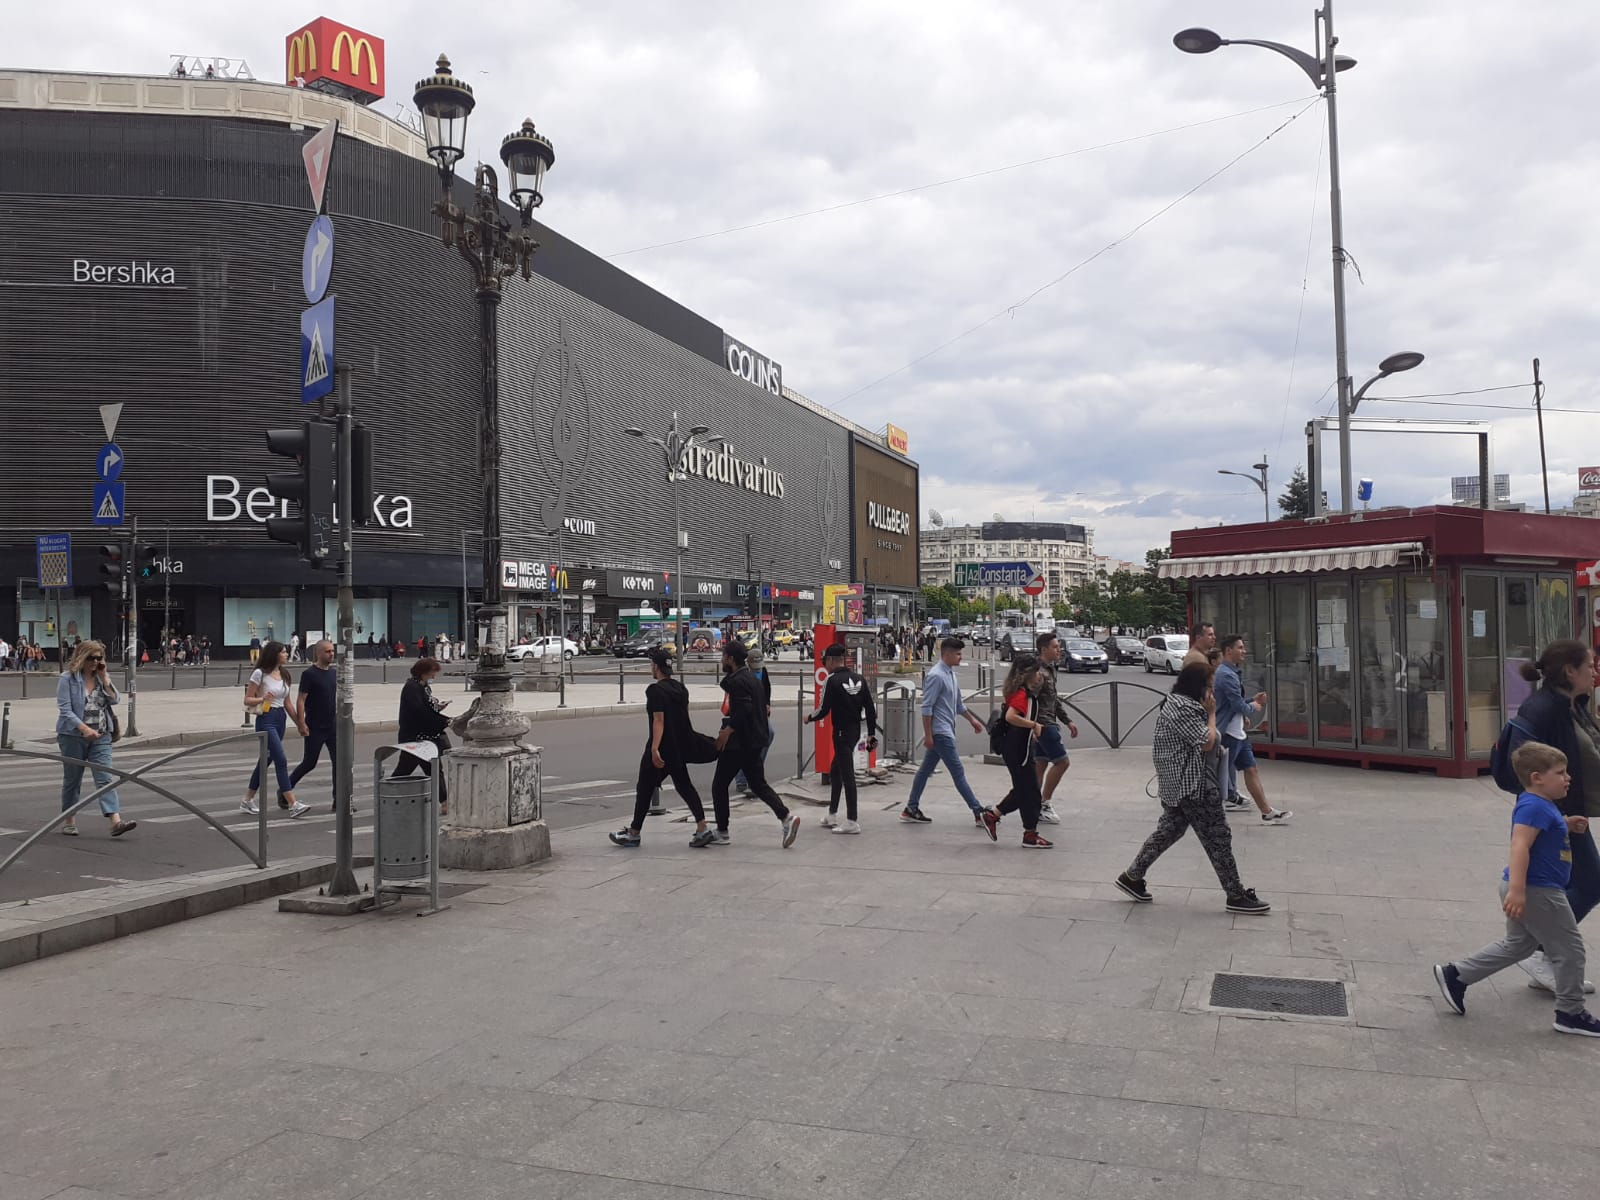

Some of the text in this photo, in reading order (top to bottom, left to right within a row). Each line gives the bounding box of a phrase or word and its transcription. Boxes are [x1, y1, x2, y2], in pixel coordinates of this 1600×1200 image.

[169, 54, 256, 80] ZARA
[73, 259, 175, 284] Bershka
[727, 343, 779, 396] COLIN'S
[206, 474, 413, 528] Berka
[867, 500, 910, 535] PULL&BEAR
[518, 561, 547, 577] MEGA
[518, 576, 548, 591] IMAGE
